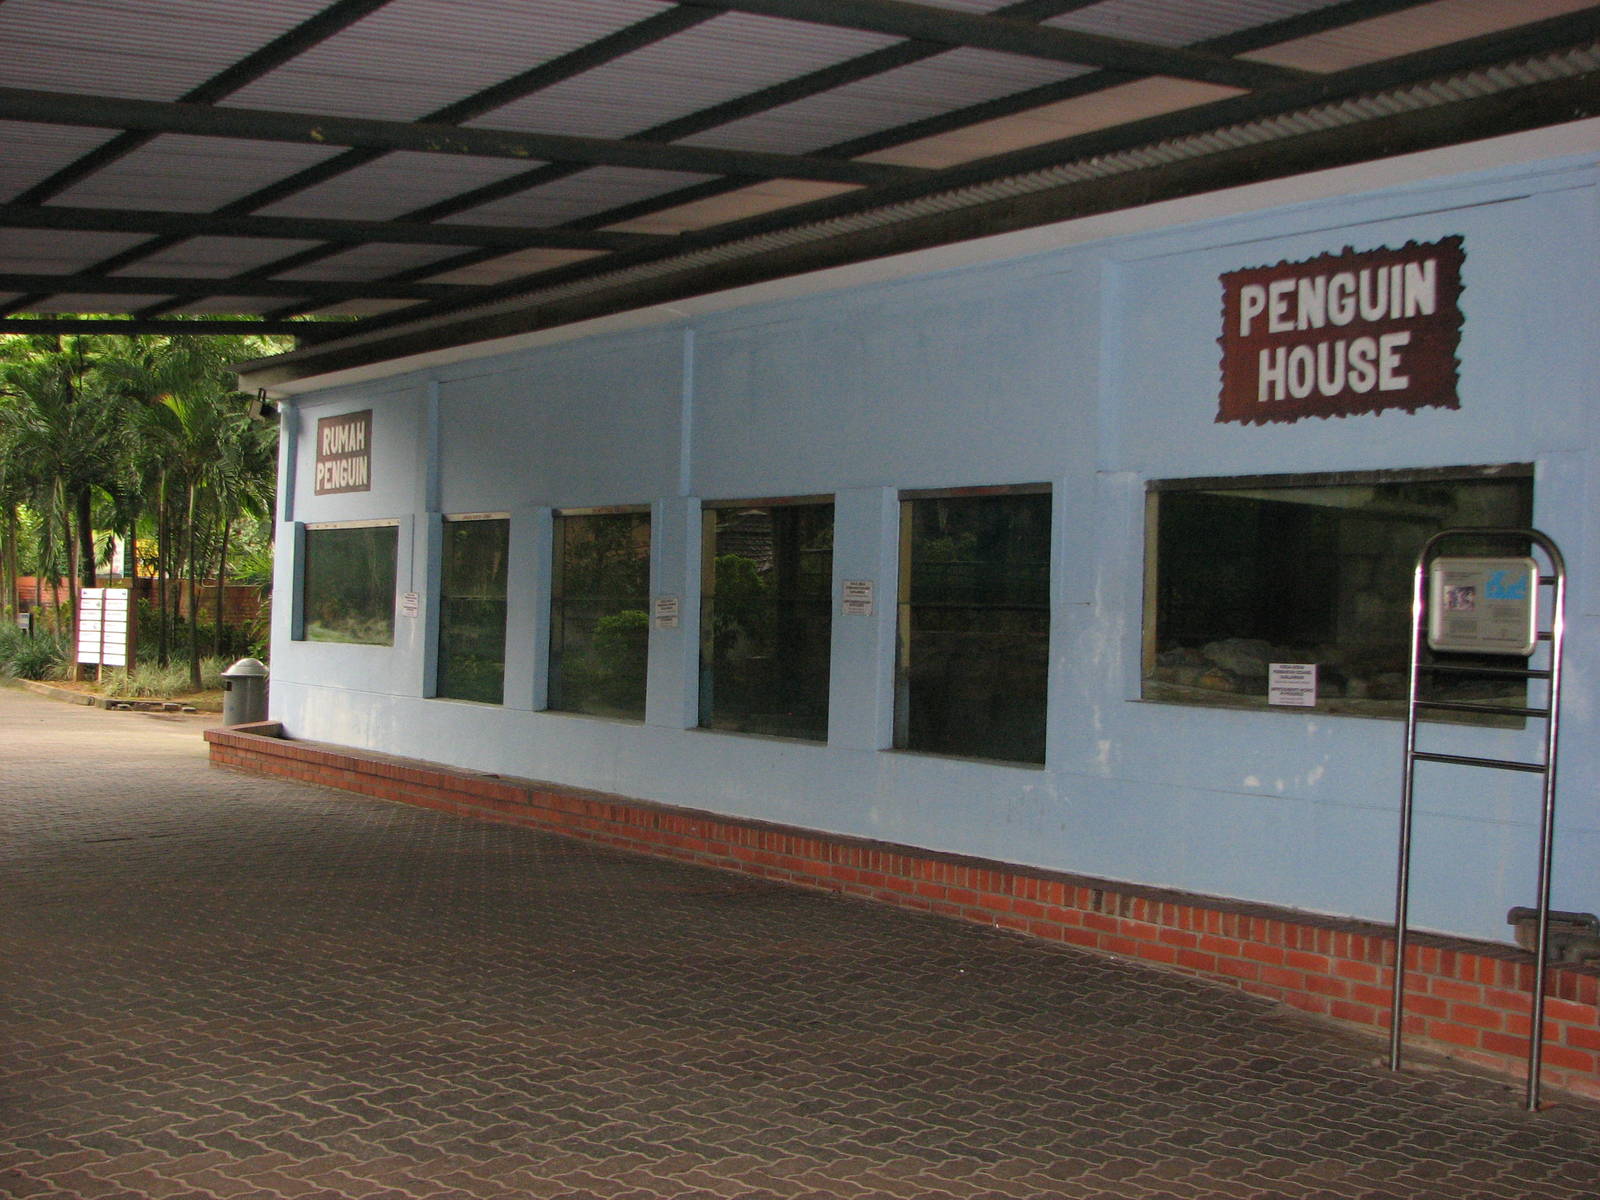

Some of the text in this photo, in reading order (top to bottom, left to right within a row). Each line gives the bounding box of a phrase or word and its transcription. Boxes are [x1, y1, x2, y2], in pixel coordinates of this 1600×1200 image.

[1240, 259, 1437, 337] PENGUIN
[1258, 331, 1411, 402] HOUSE
[322, 420, 365, 456] RUMAH
[316, 456, 368, 491] PENGUIN
